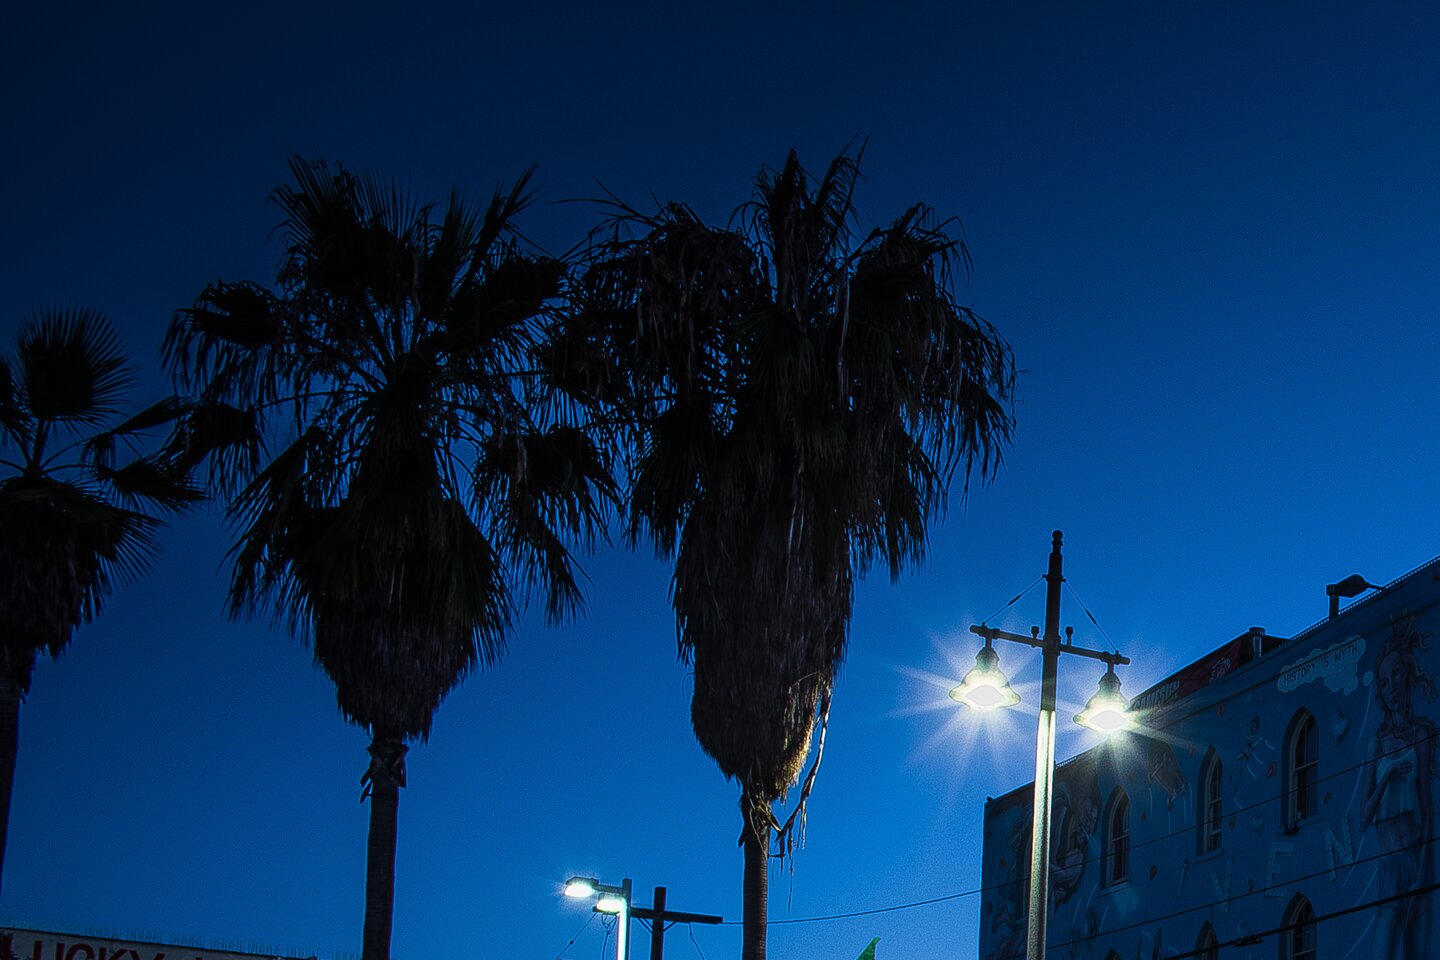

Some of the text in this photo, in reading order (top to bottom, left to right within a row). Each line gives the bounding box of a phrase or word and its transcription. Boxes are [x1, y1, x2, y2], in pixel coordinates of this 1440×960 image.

[1284, 643, 1359, 685] HISTORY IS MYTH
